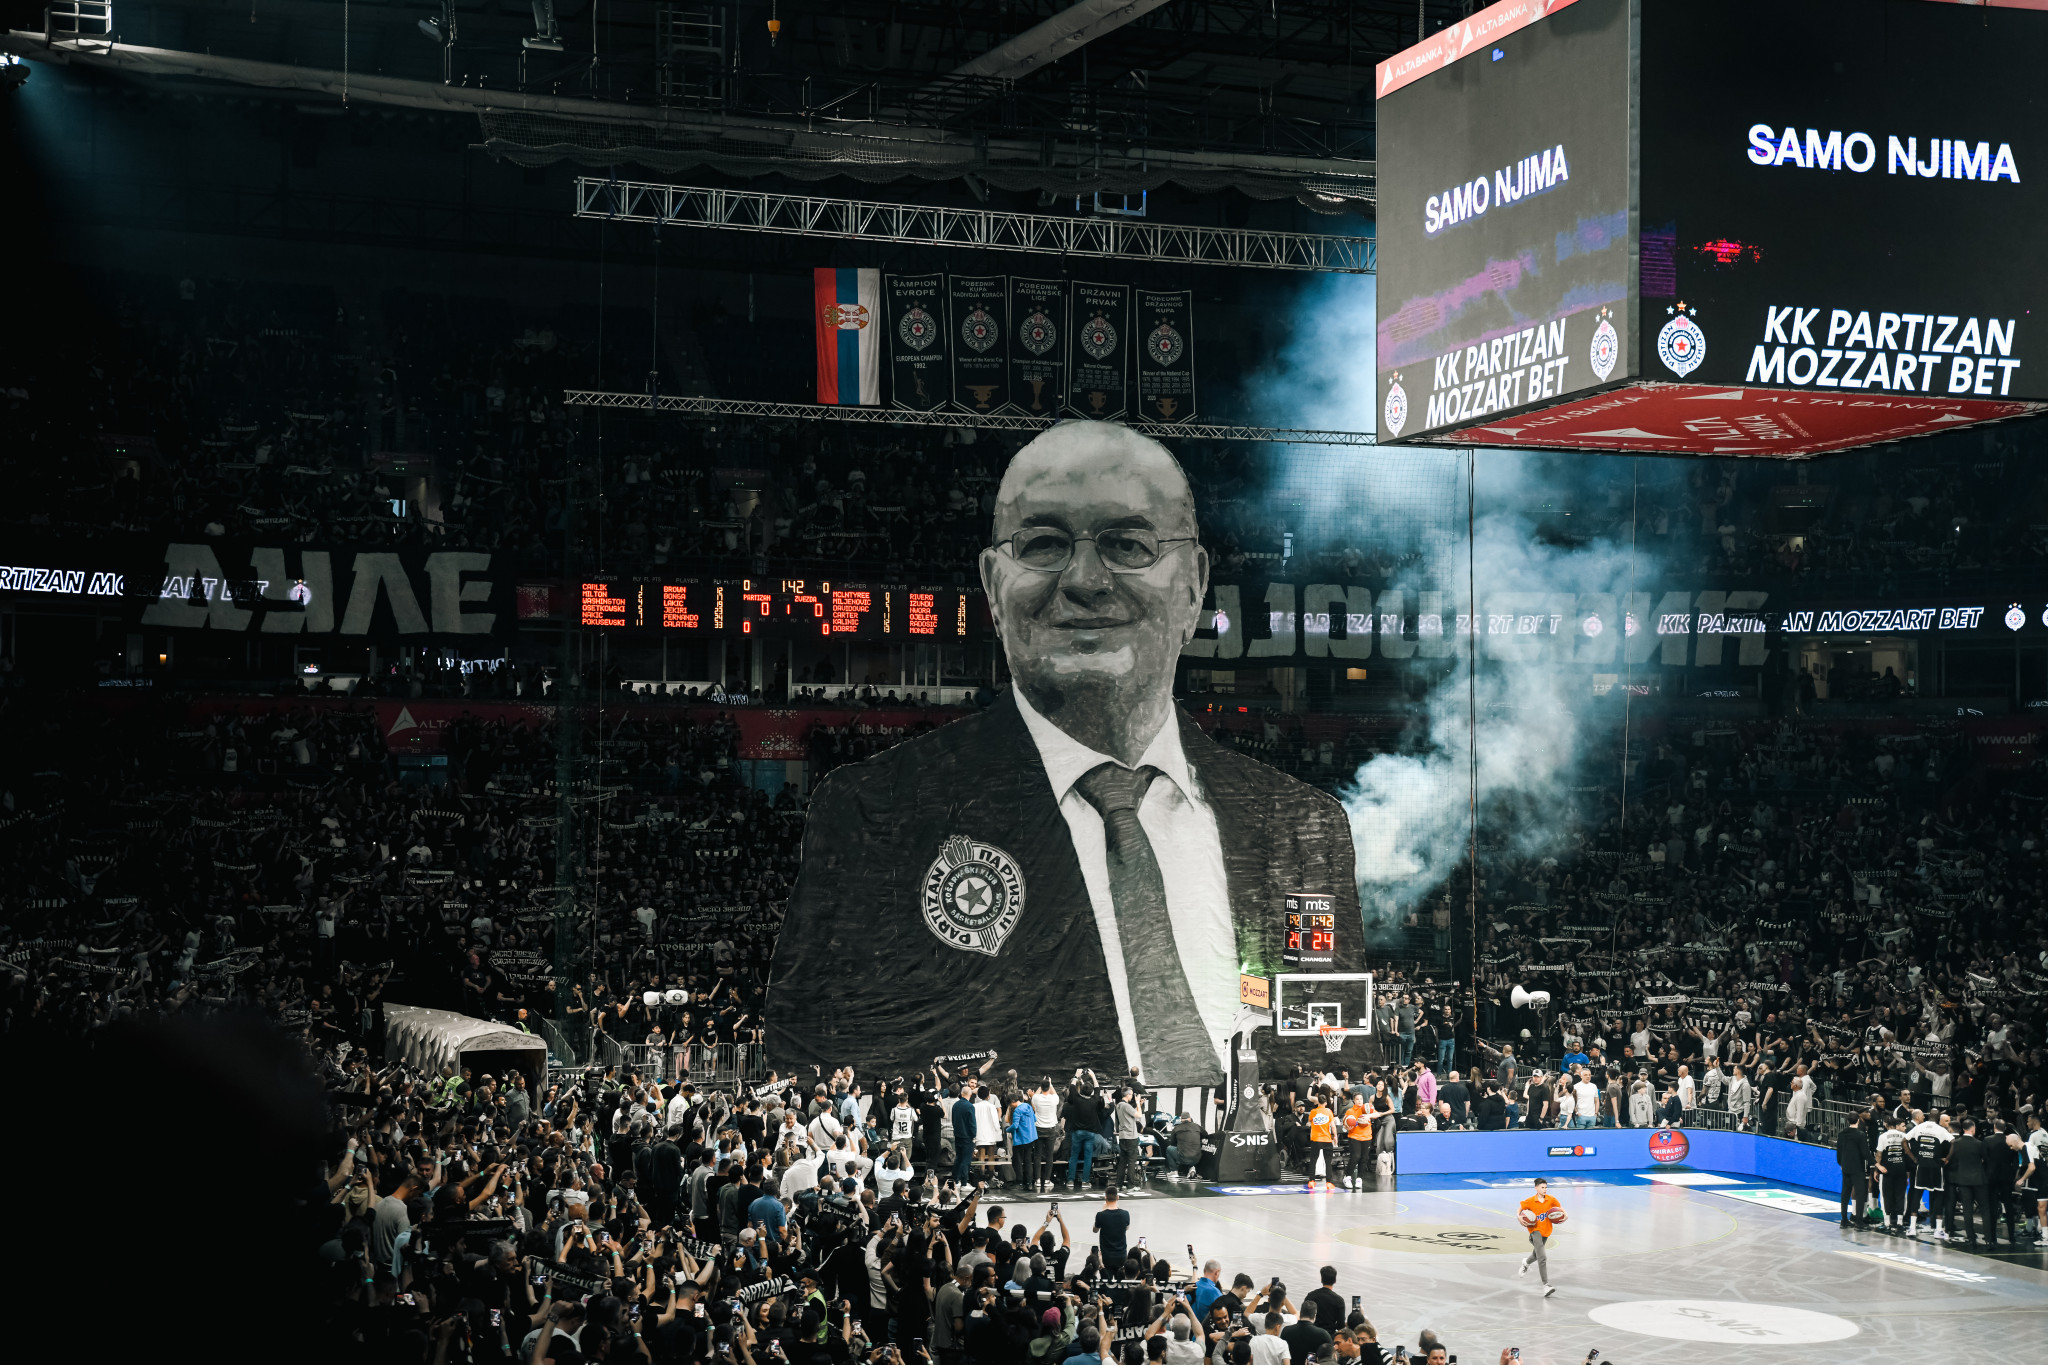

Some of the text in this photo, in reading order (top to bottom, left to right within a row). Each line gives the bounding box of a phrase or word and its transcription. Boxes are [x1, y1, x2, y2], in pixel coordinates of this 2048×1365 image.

[1475, 4, 1528, 38] ALTABANKA
[1395, 46, 1443, 78] ALTABANKA
[1748, 125, 2020, 183] SAMO NJIMA
[1425, 145, 1569, 233] SAMO NJIMA
[892, 279, 937, 288] ŠAMPION
[1019, 282, 1059, 290] POBEDNIK
[896, 288, 936, 296] EVROPE
[1016, 288, 1062, 296] JADRANSKE
[1080, 287, 1121, 298] DRŽAVNI
[1086, 298, 1118, 307] PRVAK
[1764, 306, 2017, 357] KK PARTIZAN
[1434, 318, 1566, 391] KK PARTIZAN
[1746, 345, 2020, 396] MOZZART BET
[1425, 368, 1525, 429] MOZZART
[1527, 356, 1569, 403] BET
[1756, 397, 1961, 411] ALTABANKA
[255, 517, 289, 525] PARTIZAN
[141, 543, 497, 635] ДУЛЕ
[581, 583, 608, 591] CARLIK
[663, 585, 687, 593] BROWN
[743, 580, 750, 591] 0
[782, 580, 805, 593] 1:42
[822, 582, 830, 594] 0
[581, 598, 626, 606] WASHINGTON
[743, 594, 771, 602] PARTIZAN
[794, 595, 817, 603] ZVEZDA
[832, 598, 872, 606] MILJENOVIC
[909, 593, 934, 601] RIVERO
[761, 602, 770, 616] 0
[786, 604, 790, 615] 1
[815, 603, 823, 617] 0
[832, 605, 870, 613] DAVIDOVAC
[581, 619, 643, 627] POKUSEVSKI 11
[1180, 582, 1771, 667] УЈОШЕВИЋ
[1657, 613, 1690, 634] KK
[1816, 608, 1937, 632] MOZZART
[1938, 606, 1985, 629] BET
[743, 621, 750, 634] 0
[822, 623, 830, 635] 0
[832, 625, 858, 633] DOBRIC
[909, 627, 966, 636] MONEKE 95
[979, 849, 1020, 930] ПАРТИЗАН
[928, 866, 971, 944] PARTIZAN
[1286, 898, 1299, 910] mts
[1305, 899, 1330, 911] mts
[743, 923, 781, 931] ГРОБАР
[1311, 915, 1334, 927] 1:42
[1288, 931, 1300, 948] 24
[1312, 932, 1334, 950] 24
[1749, 982, 1779, 992] PARTIZAN
[756, 1078, 789, 1096] ПАРТИЗАН
[898, 1121, 908, 1132] 12
[1246, 1134, 1269, 1146] NIS
[1369, 1231, 1501, 1250] MOZZART
[740, 1277, 783, 1302] PARTIZAN
[1704, 1319, 1785, 1336] NIS
